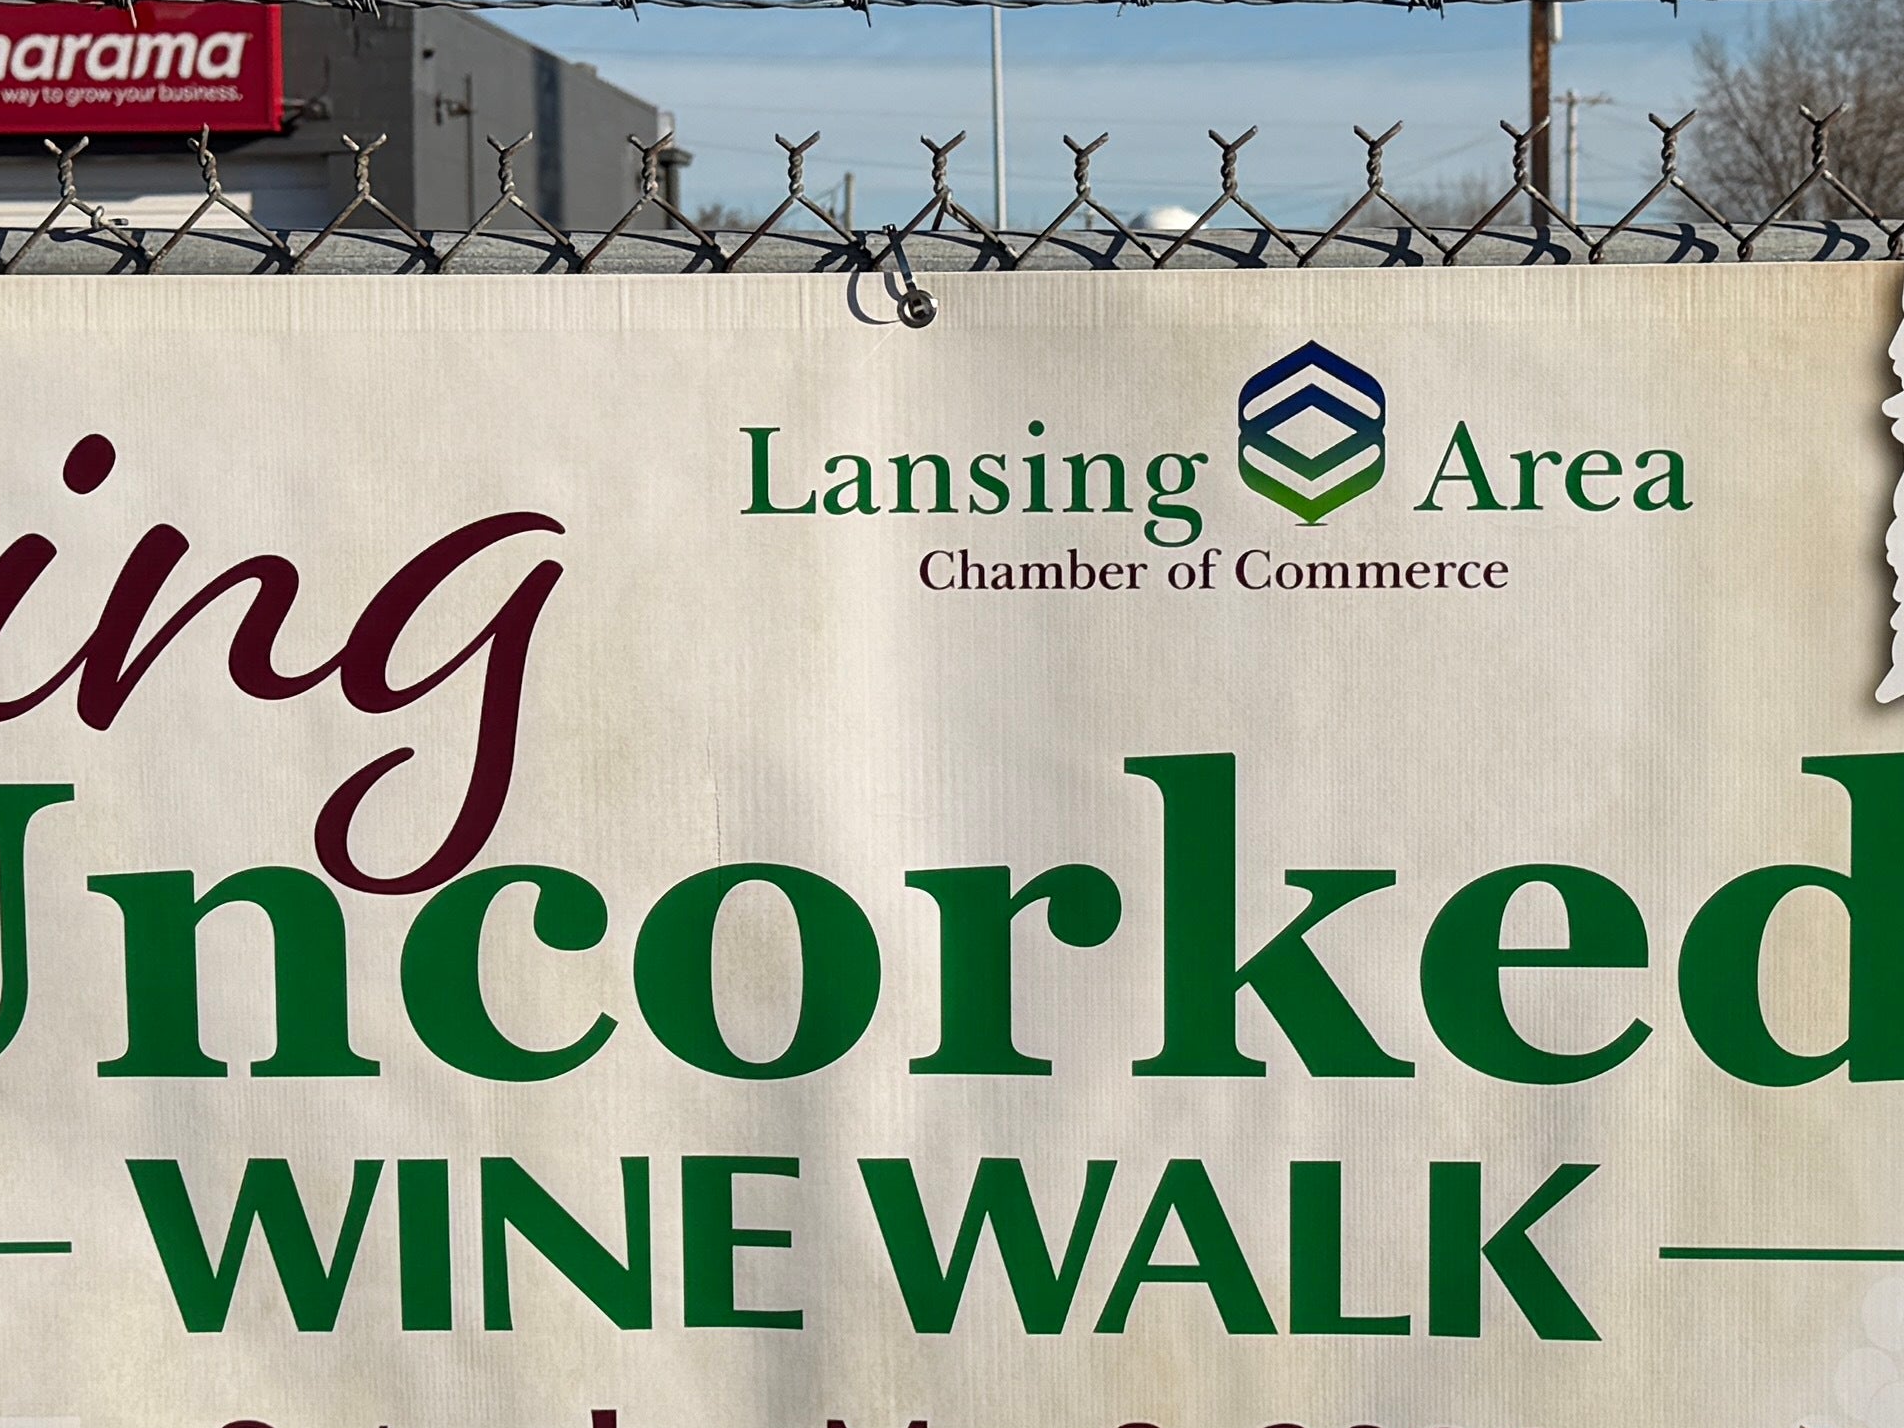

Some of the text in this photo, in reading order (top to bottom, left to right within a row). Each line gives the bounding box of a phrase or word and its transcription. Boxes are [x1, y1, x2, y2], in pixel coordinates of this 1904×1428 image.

[0, 88, 39, 108] way
[42, 85, 64, 104] to
[65, 88, 112, 108] grow
[113, 87, 157, 107] your
[738, 419, 1693, 548] Lansing Area
[919, 548, 1510, 591] Chamber of Commerce
[128, 1157, 1599, 1341] WINE WALK
